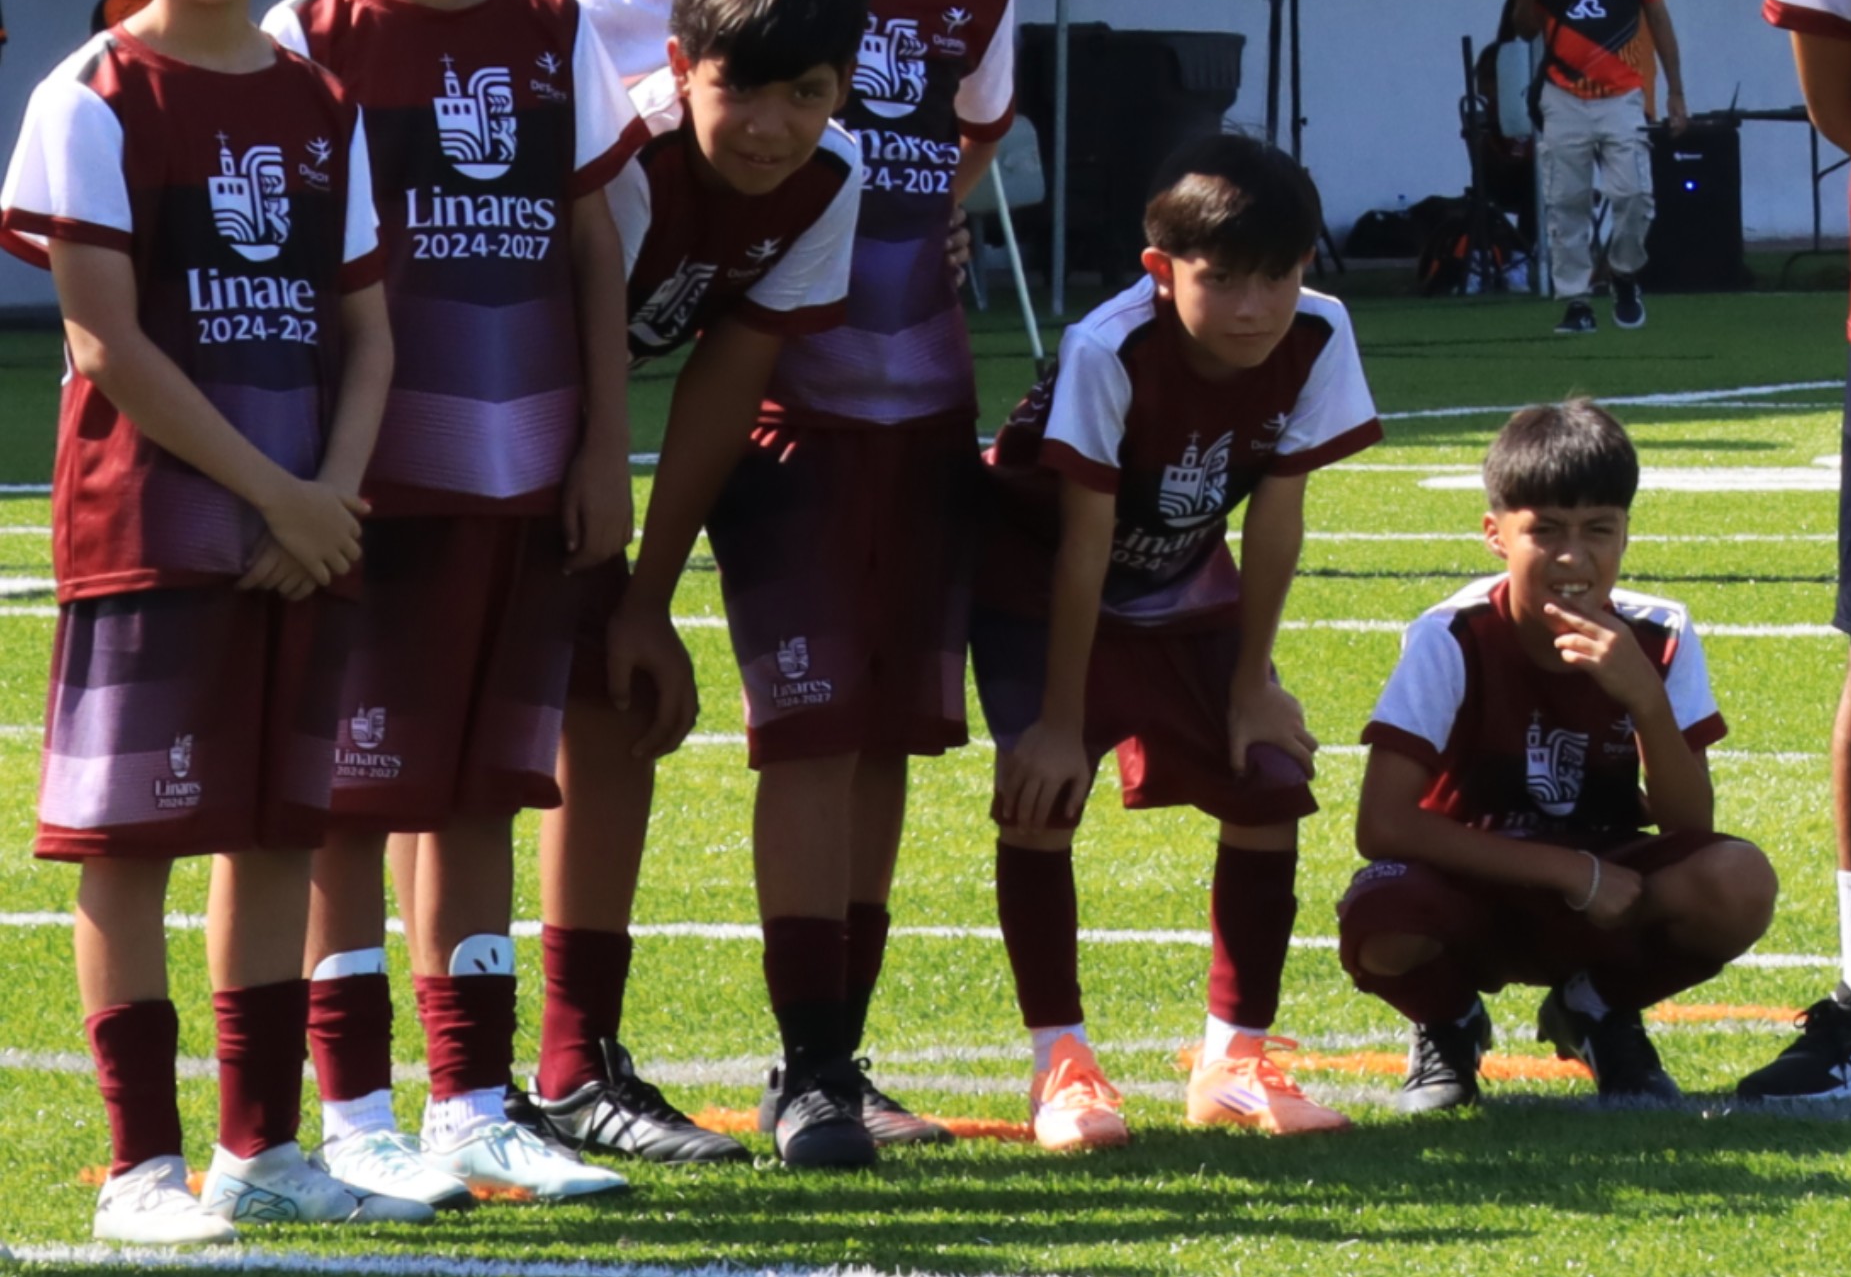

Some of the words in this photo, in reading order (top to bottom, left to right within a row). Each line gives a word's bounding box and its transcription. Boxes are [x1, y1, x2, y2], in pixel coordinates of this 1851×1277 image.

[405, 186, 557, 231] Linares
[412, 232, 551, 261] 2024-2027
[335, 748, 402, 768] Linares
